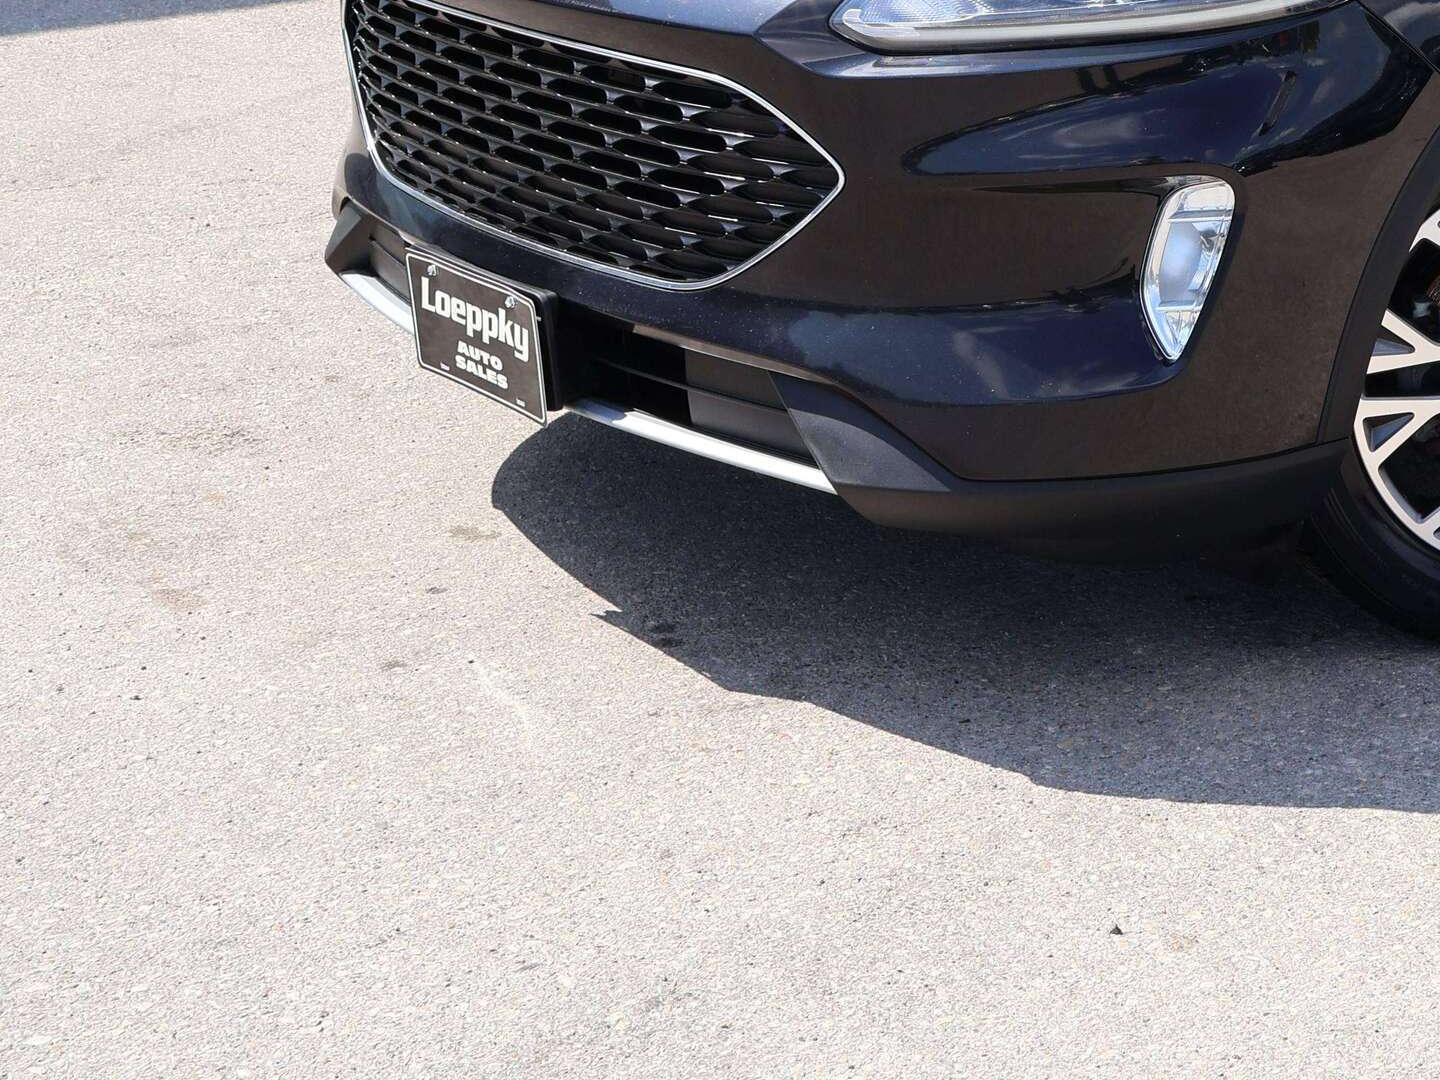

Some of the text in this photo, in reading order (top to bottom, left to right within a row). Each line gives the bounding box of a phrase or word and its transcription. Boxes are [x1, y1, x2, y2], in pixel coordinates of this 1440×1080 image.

[421, 276, 530, 363] Loeppky
[455, 354, 509, 390] SALES
[457, 340, 504, 371] AUTO
